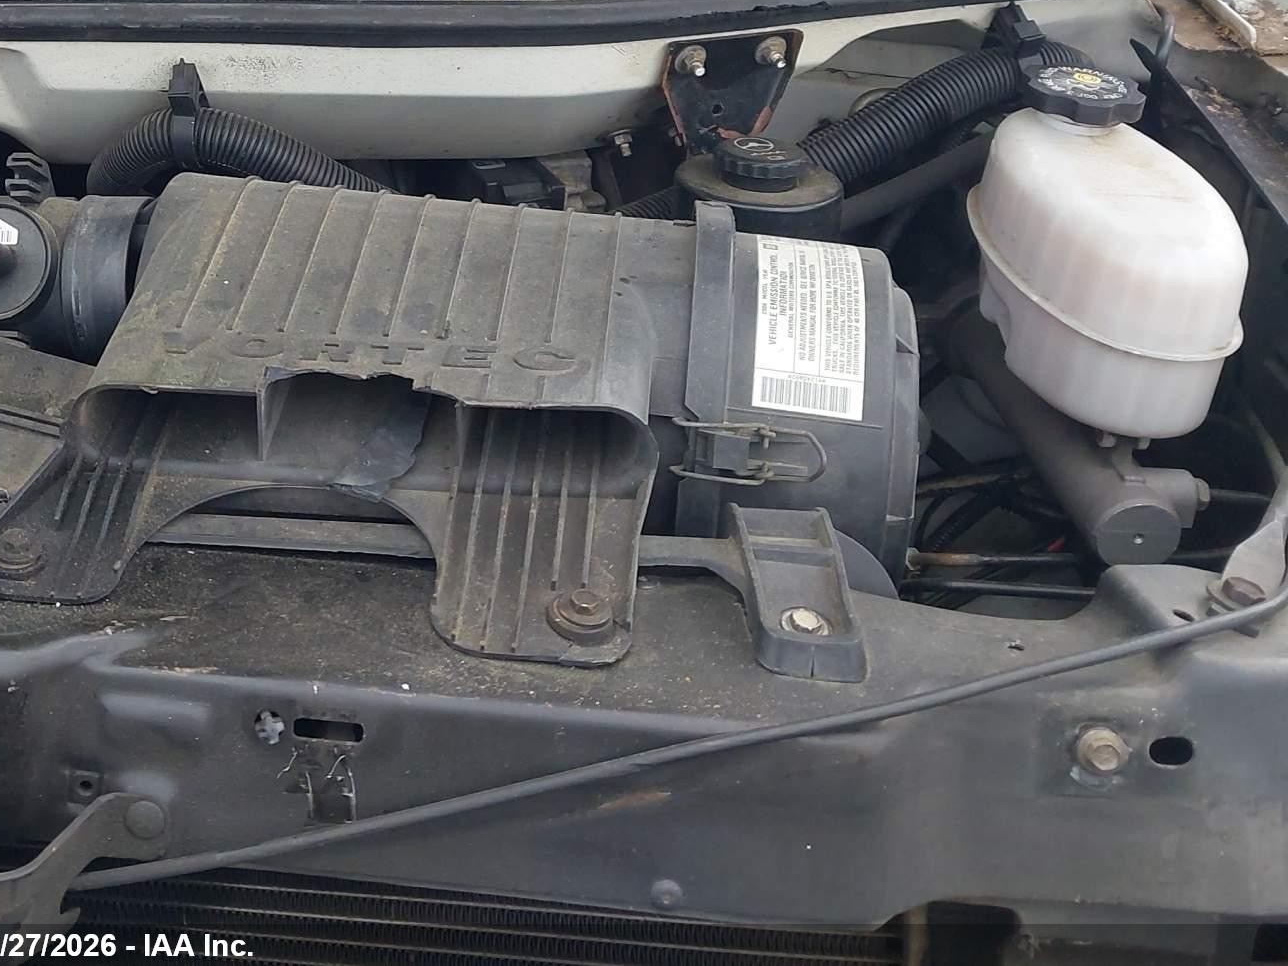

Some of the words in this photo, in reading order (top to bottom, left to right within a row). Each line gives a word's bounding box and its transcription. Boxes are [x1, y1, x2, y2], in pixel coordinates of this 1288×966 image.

[770, 255, 778, 275] CONTROL
[770, 277, 778, 310] EMISSION
[768, 313, 777, 345] VEHICLE
[162, 327, 590, 376] VORTEC
